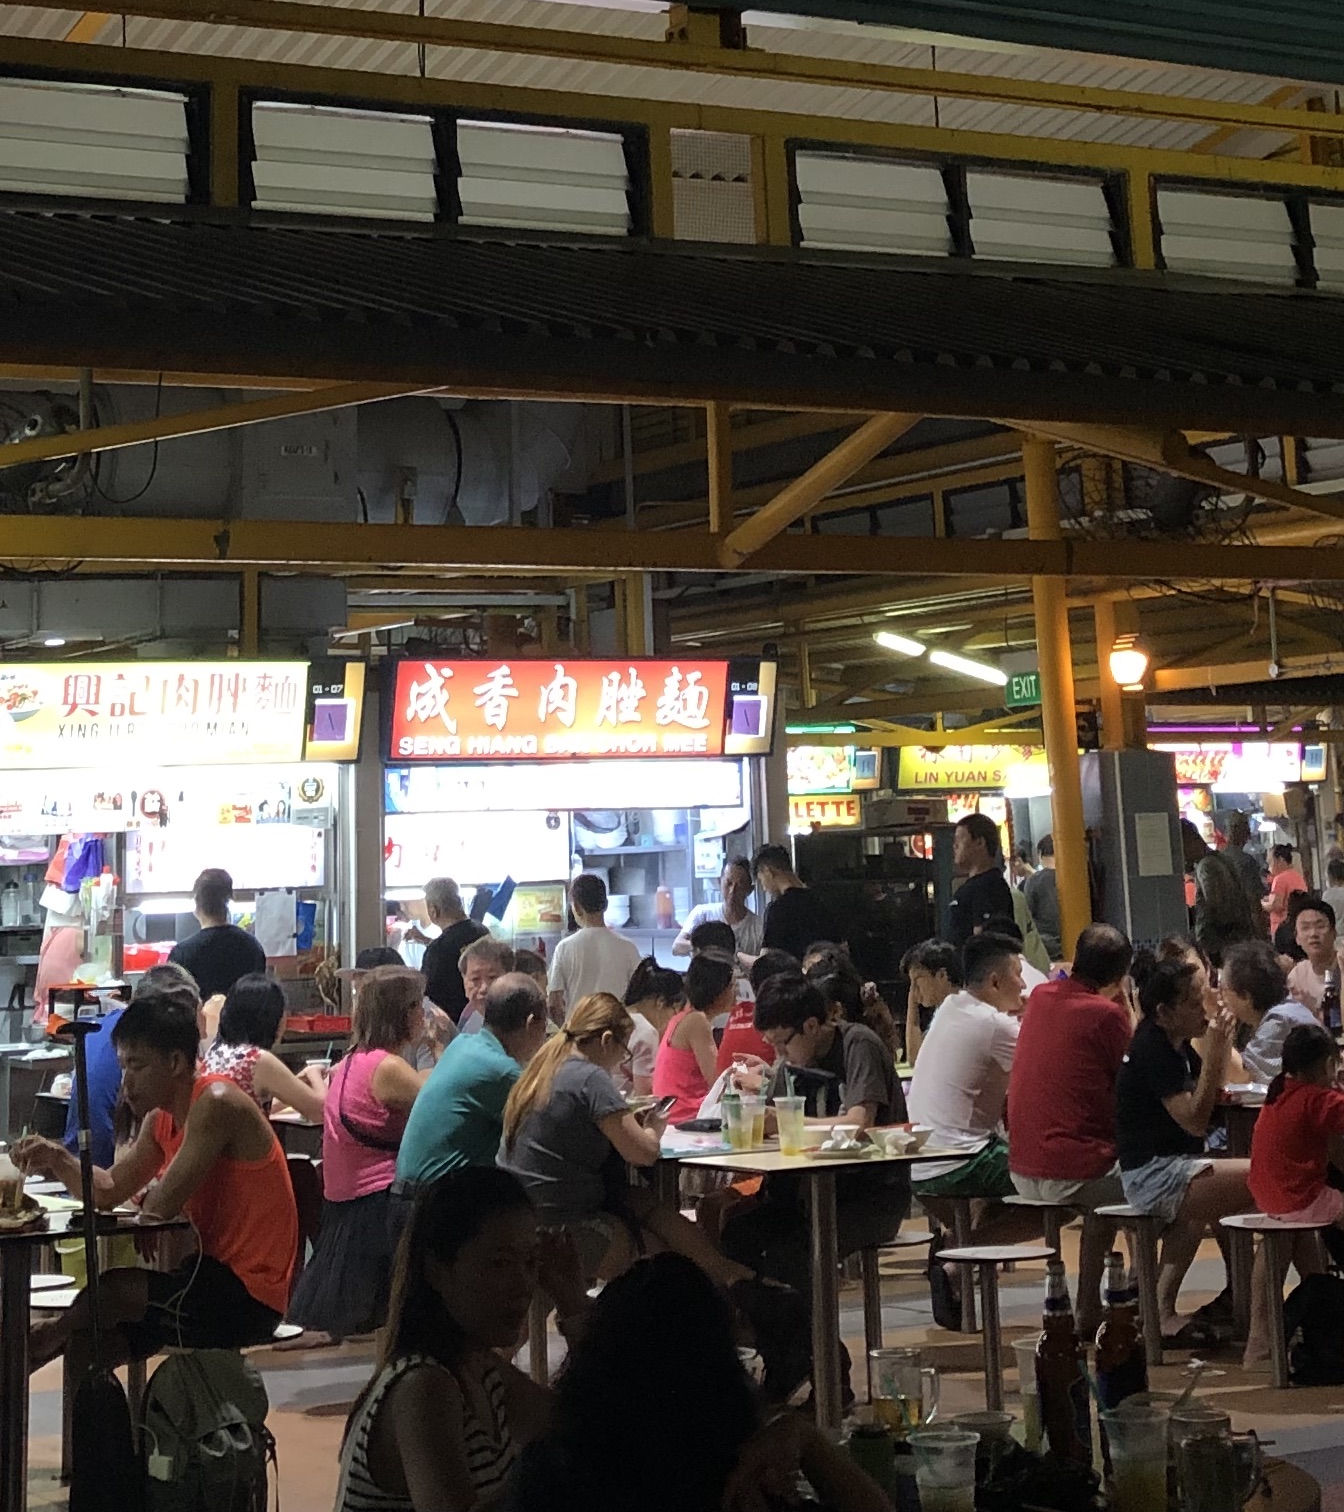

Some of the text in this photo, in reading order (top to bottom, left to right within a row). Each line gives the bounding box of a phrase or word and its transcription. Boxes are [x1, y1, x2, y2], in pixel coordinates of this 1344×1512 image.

[1012, 675, 1036, 699] EXIT
[58, 722, 100, 740] XING
[399, 735, 461, 756] SENG
[468, 734, 538, 756] HIANG
[662, 732, 708, 754] MEE
[914, 771, 939, 784] LIN
[945, 770, 988, 783] YUAN
